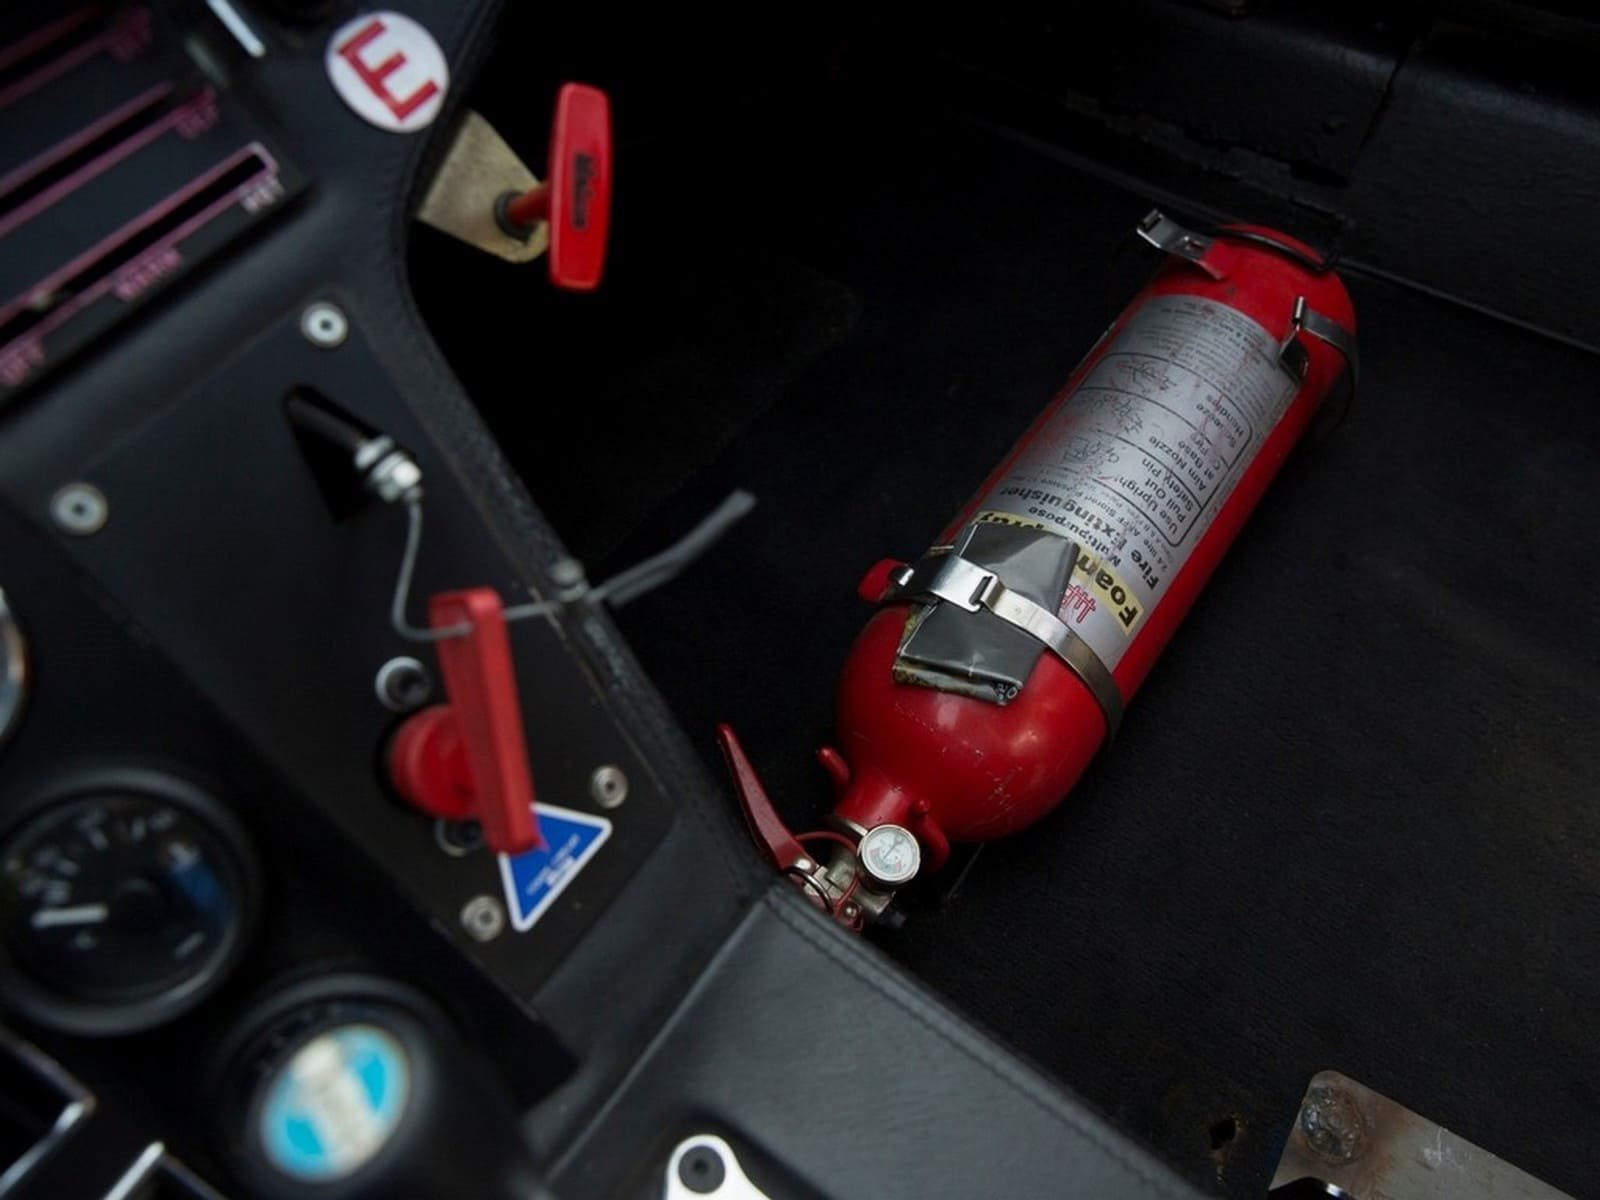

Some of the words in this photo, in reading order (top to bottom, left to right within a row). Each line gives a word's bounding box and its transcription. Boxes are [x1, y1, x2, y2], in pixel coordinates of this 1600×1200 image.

[338, 20, 438, 121] E
[1149, 436, 1188, 470] Nozzle
[1178, 440, 1203, 469] Base
[1190, 432, 1208, 455] Fire
[1142, 458, 1162, 478] Pin
[1188, 467, 1206, 491] Aim
[1203, 470, 1215, 480] at
[1114, 476, 1158, 511] Uprigh
[1144, 478, 1166, 500] Out
[1162, 471, 1194, 512] Safety
[1000, 485, 1128, 550] Extinguisher
[1159, 510, 1178, 534] Use
[1165, 498, 1186, 523] Pull
[1028, 506, 1121, 567] Multipurpose
[1130, 549, 1160, 590] Fire
